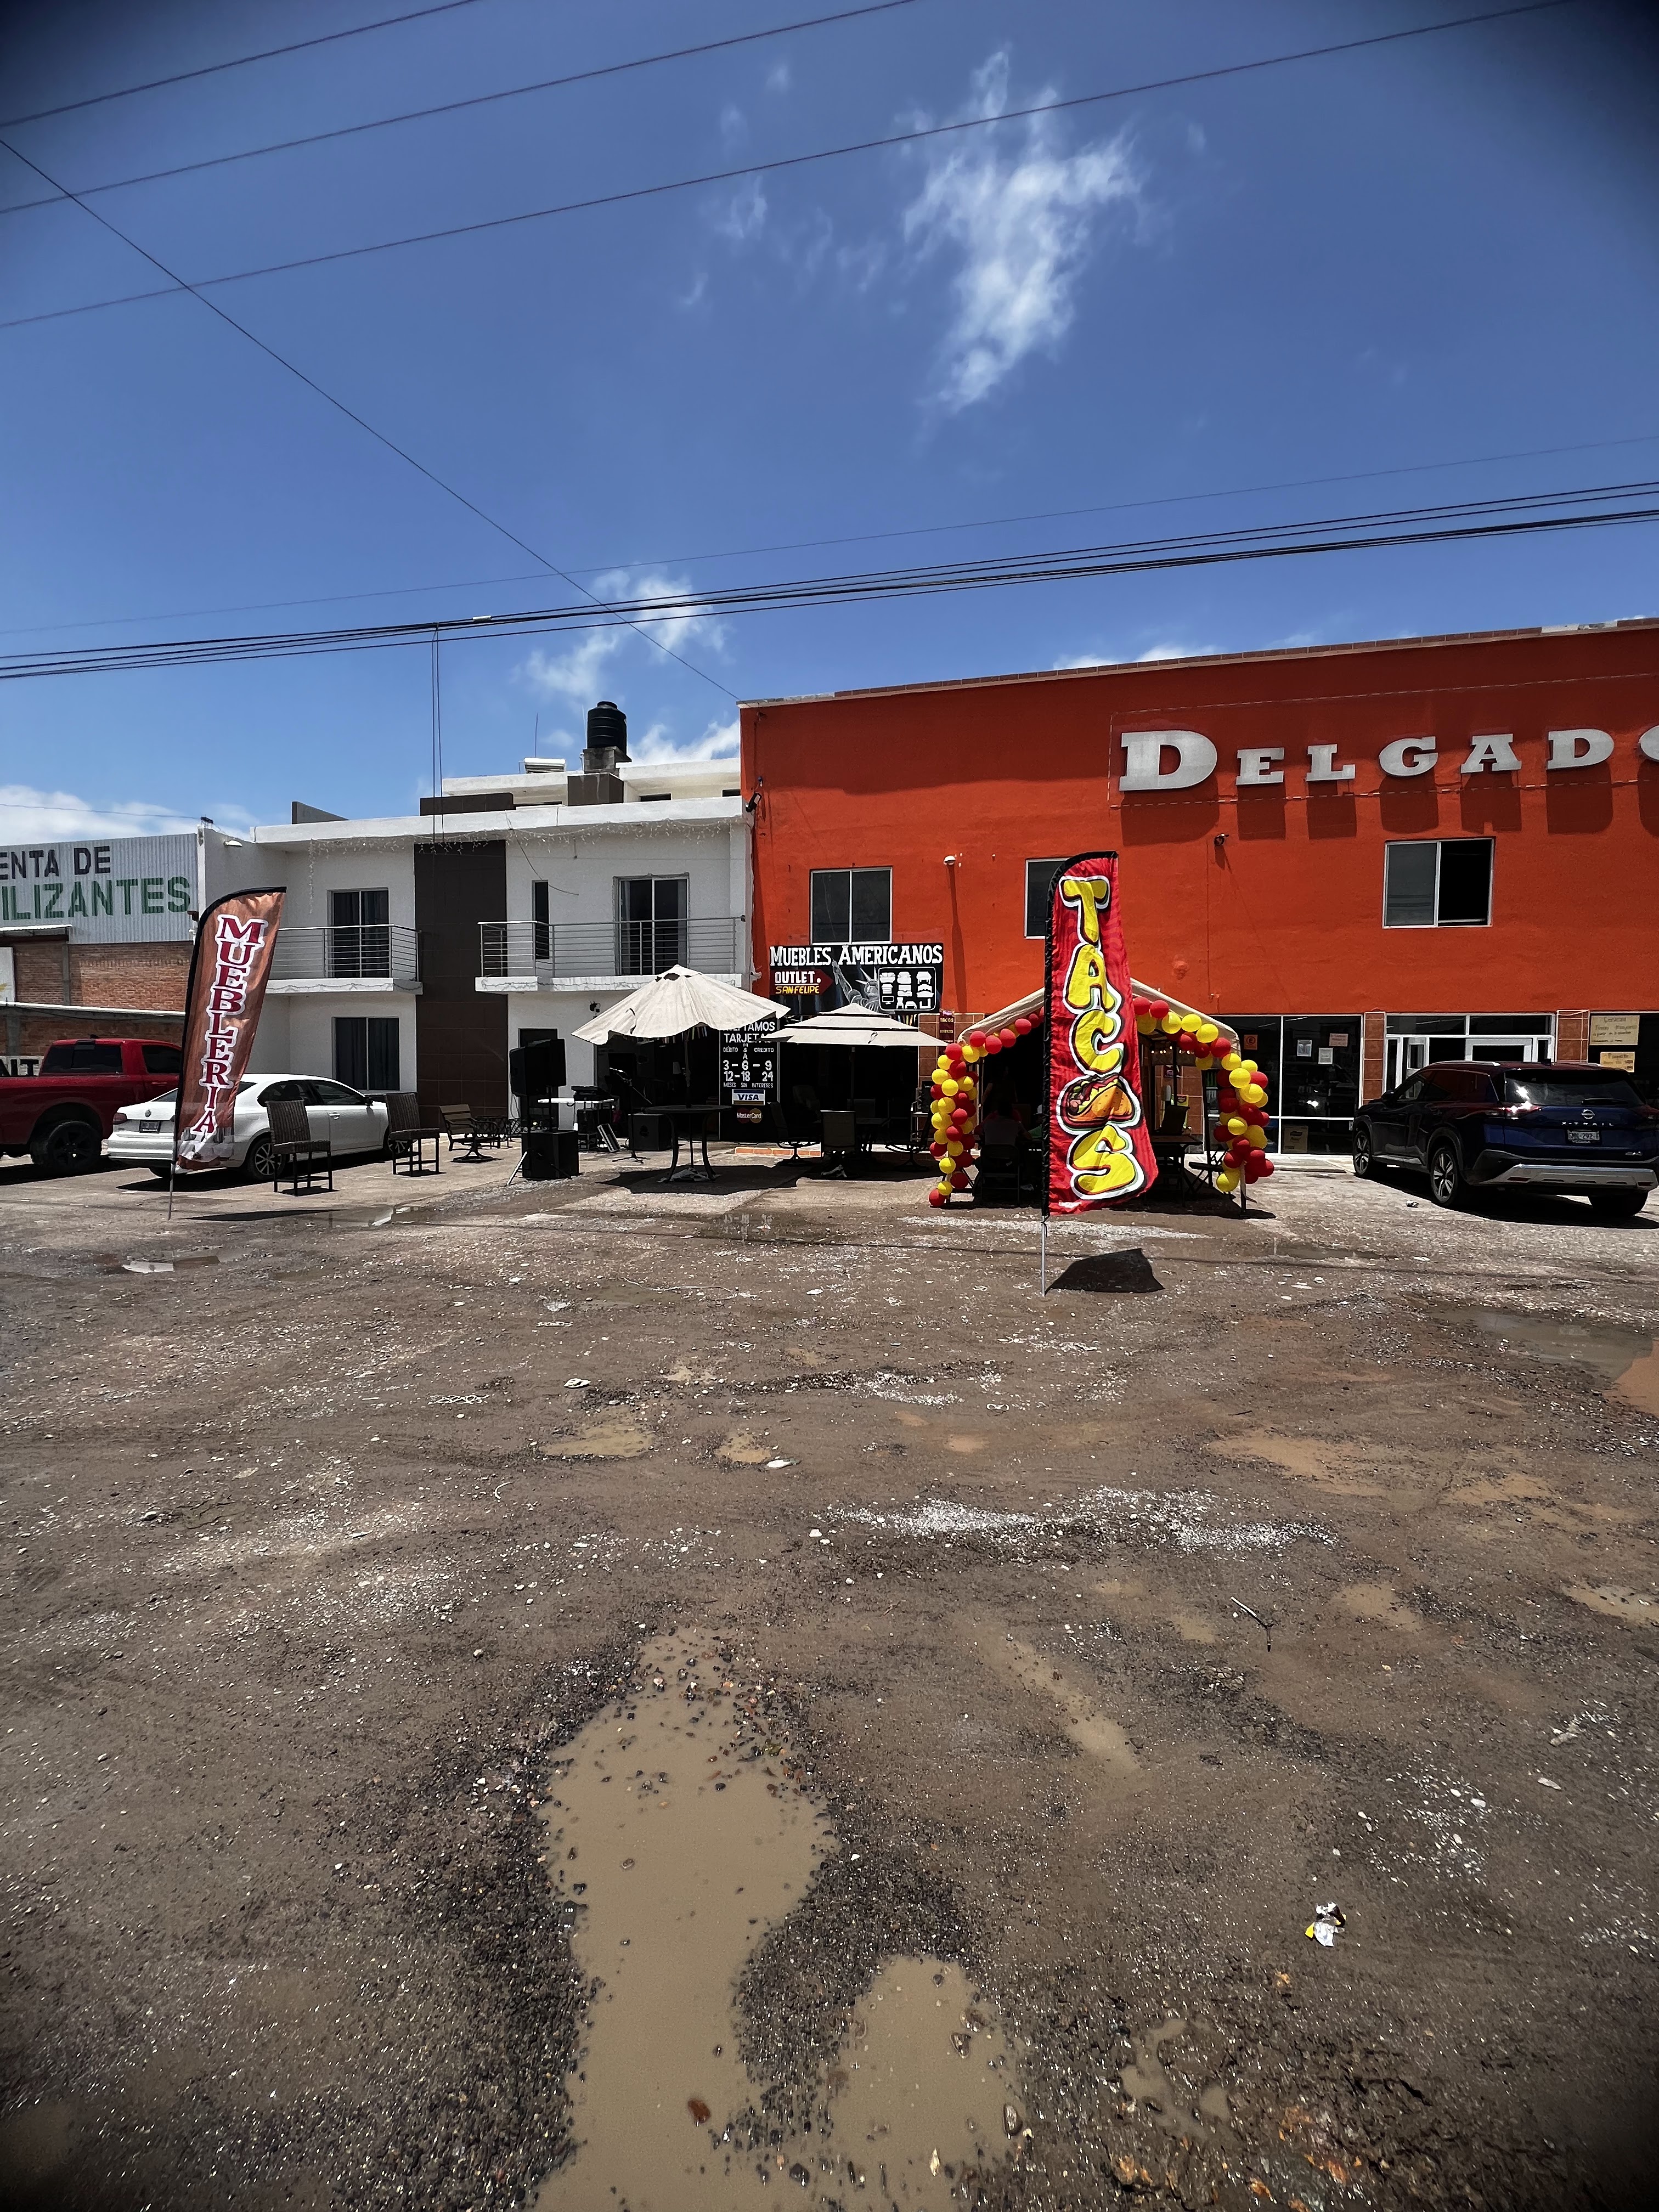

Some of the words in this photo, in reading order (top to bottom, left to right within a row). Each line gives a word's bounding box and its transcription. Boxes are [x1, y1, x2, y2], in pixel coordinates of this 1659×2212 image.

[74, 845, 111, 876] DE
[2, 876, 191, 921] ILIZANTES
[770, 946, 832, 967] MUEBLES
[838, 945, 944, 966] AMERICANOS
[193, 914, 268, 1136] MUEBLERIA
[724, 1033, 772, 1043] TARJET
[723, 1059, 730, 1070] 3
[742, 1060, 749, 1070] 6
[765, 1060, 772, 1071] 9
[761, 1071, 774, 1082] 24
